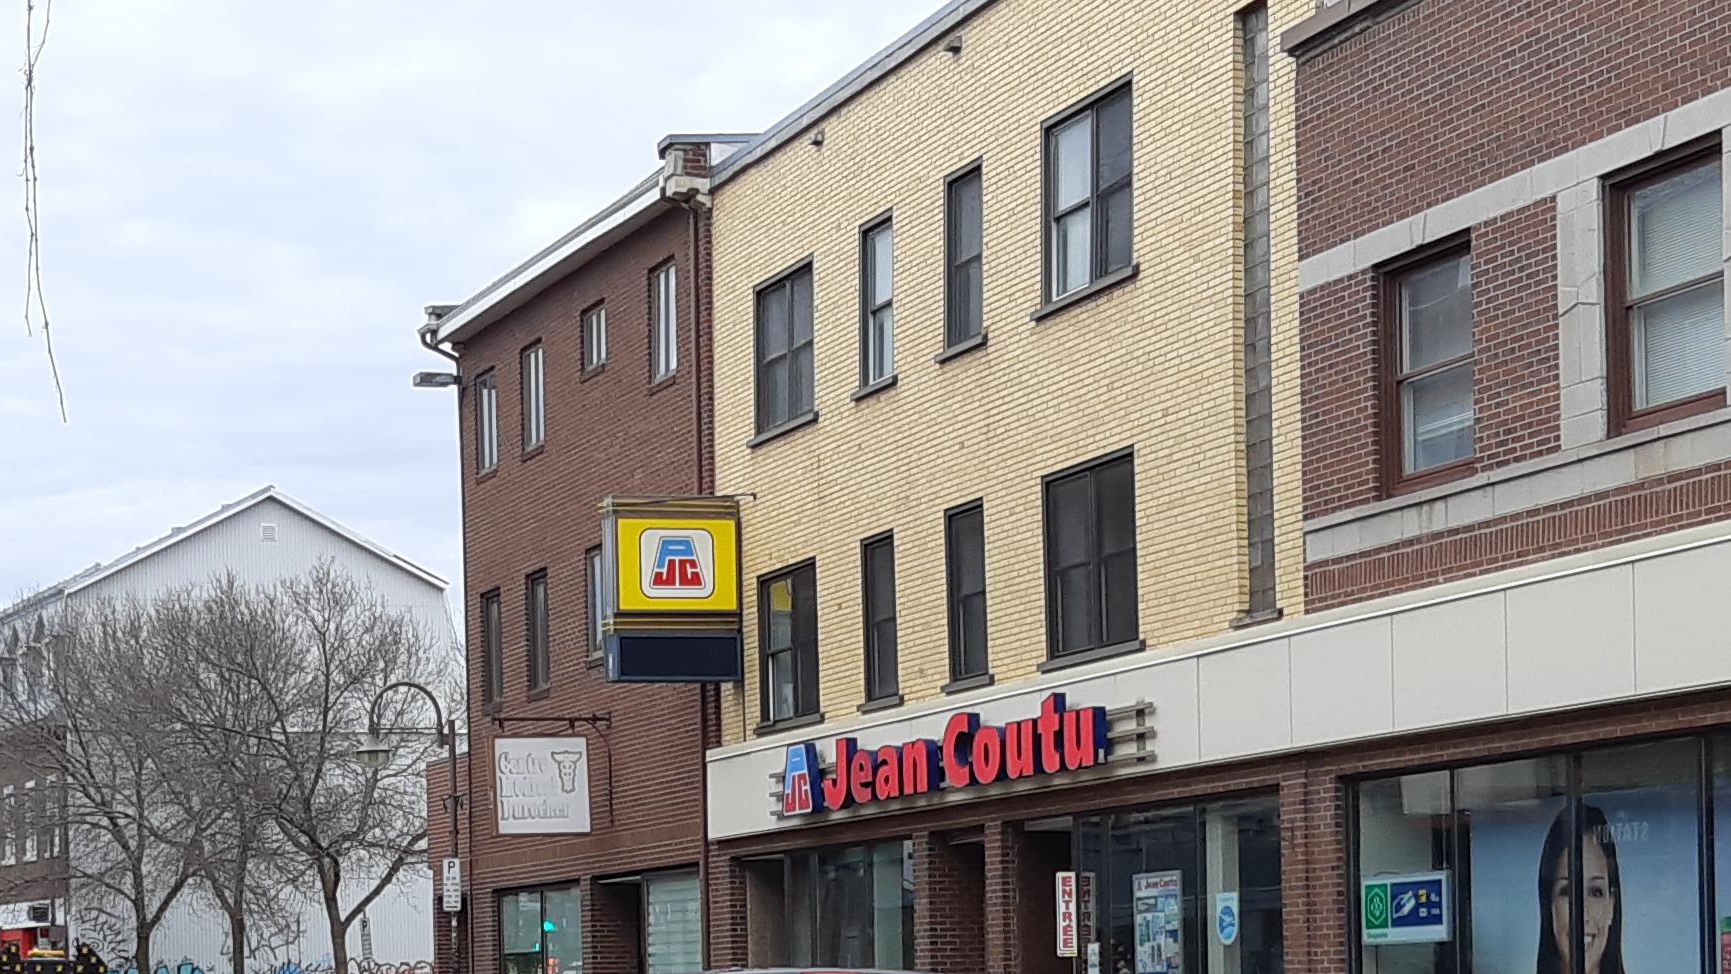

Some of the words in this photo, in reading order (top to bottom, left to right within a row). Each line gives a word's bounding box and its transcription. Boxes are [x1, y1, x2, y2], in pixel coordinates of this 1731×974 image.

[824, 738, 933, 811] Jean
[943, 692, 1103, 788] Coutu
[447, 860, 456, 875] P
[1060, 875, 1074, 949] ENTRÉE
